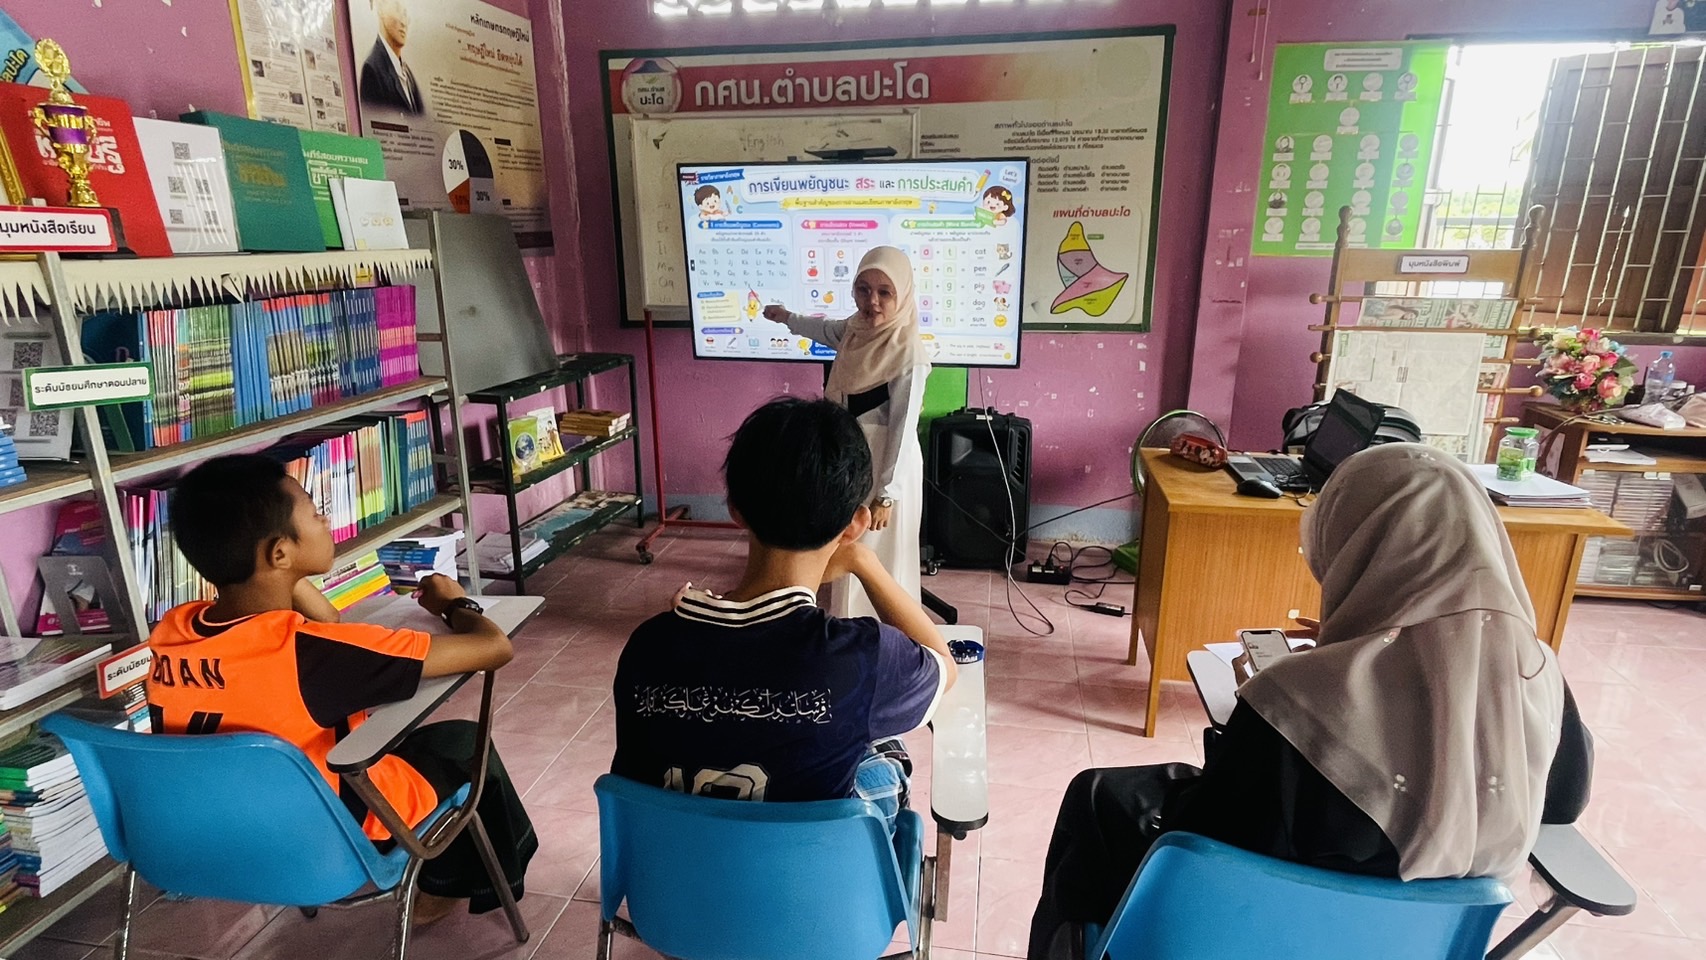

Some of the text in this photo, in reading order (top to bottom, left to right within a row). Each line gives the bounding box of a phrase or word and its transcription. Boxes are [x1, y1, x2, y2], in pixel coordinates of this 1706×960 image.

[0, 49, 29, 82] ลปะโด
[695, 61, 929, 106] กศน.ตำบลปะโด
[639, 92, 664, 105] ปะโด
[448, 158, 464, 171] 30%
[1028, 155, 1060, 164] ดต่อดังนี้
[749, 174, 973, 193] การเขียนพยัญชนะ สระ และ การประสมคำ
[1053, 205, 1131, 218] แผนที่ตำบลปะโด
[0, 219, 96, 238] มุมหนังสือเรียน
[837, 250, 844, 259] e
[973, 265, 987, 274] pen
[810, 289, 819, 298] o
[974, 283, 985, 291] pig
[972, 299, 986, 308] dog
[34, 376, 147, 394] ระดับมัธยมศึกษาตอนปลาย
